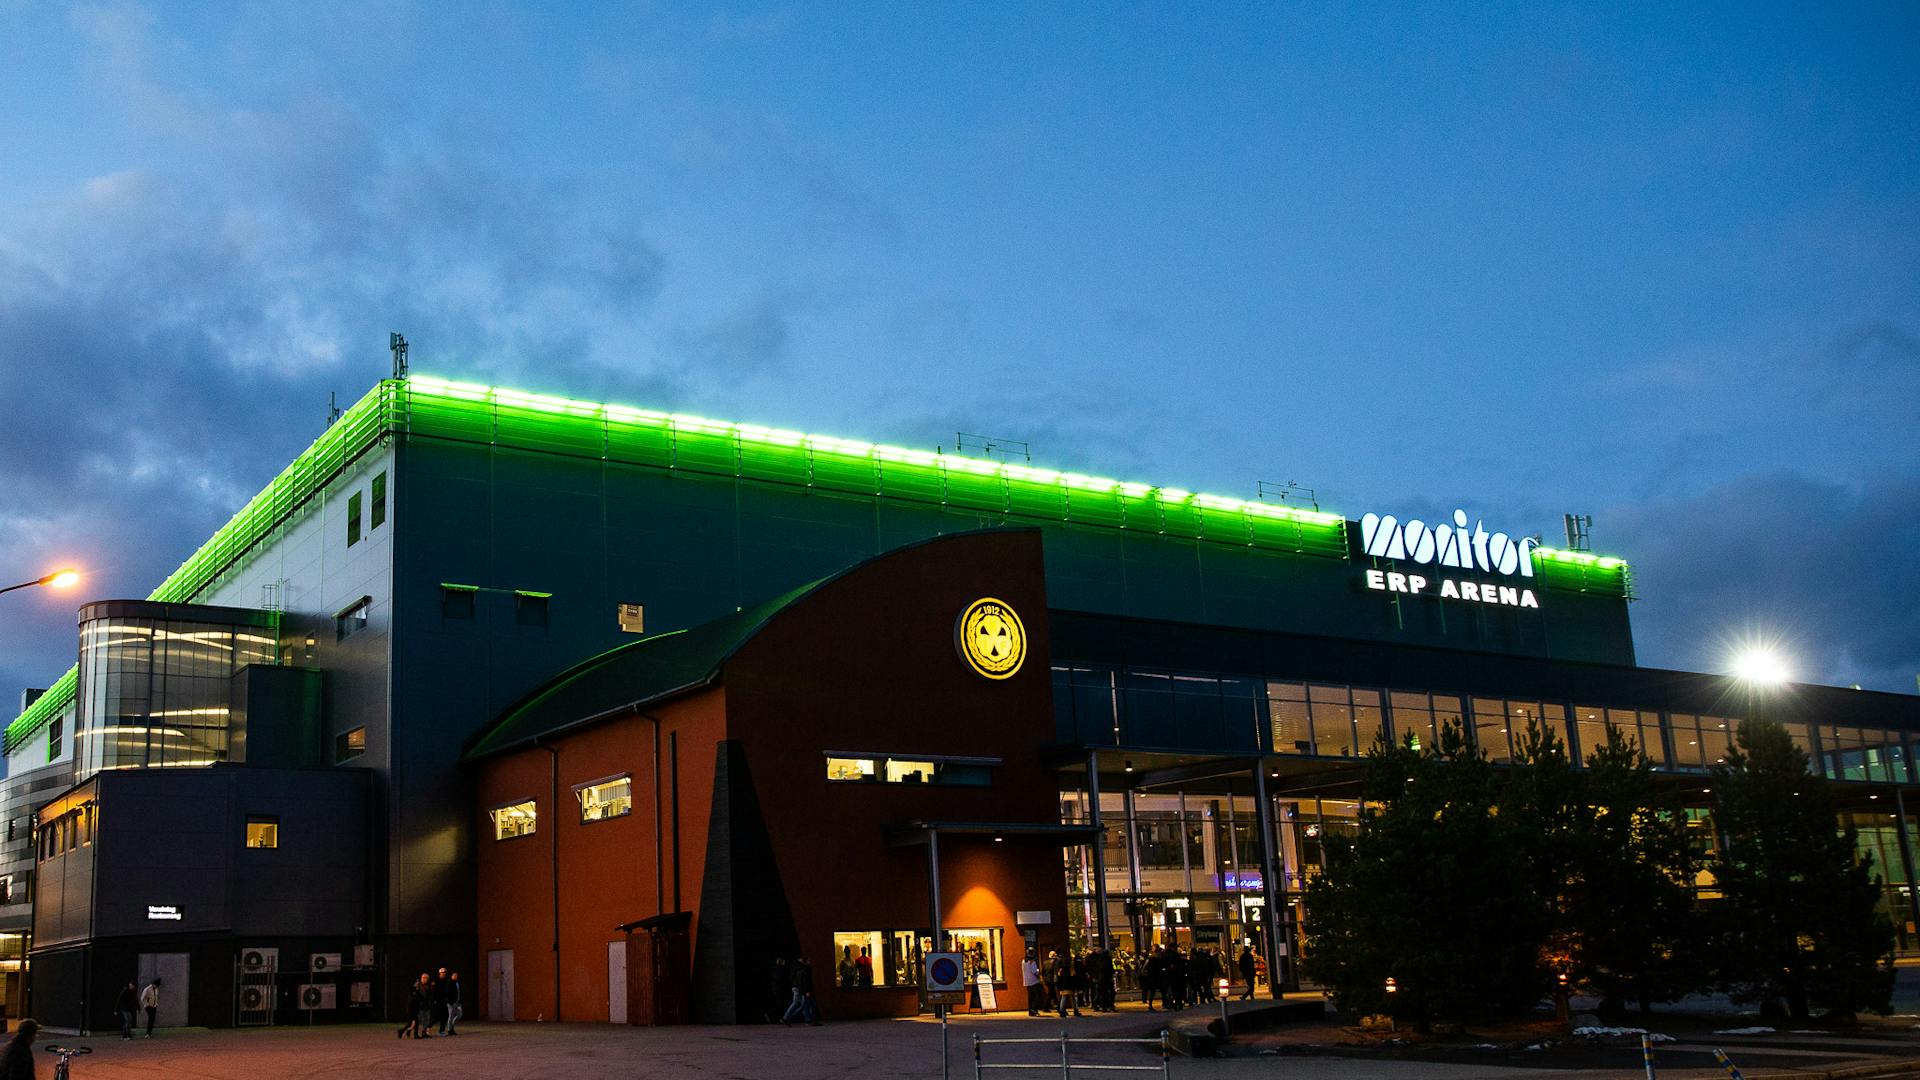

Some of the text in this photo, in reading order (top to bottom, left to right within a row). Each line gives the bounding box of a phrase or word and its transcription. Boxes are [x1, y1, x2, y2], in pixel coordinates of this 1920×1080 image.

[1361, 508, 1540, 578] monitor
[1366, 569, 1539, 609] ERP ARENA
[983, 605, 1000, 615] 1912
[1174, 908, 1183, 923] 1
[1251, 907, 1261, 921] 2
